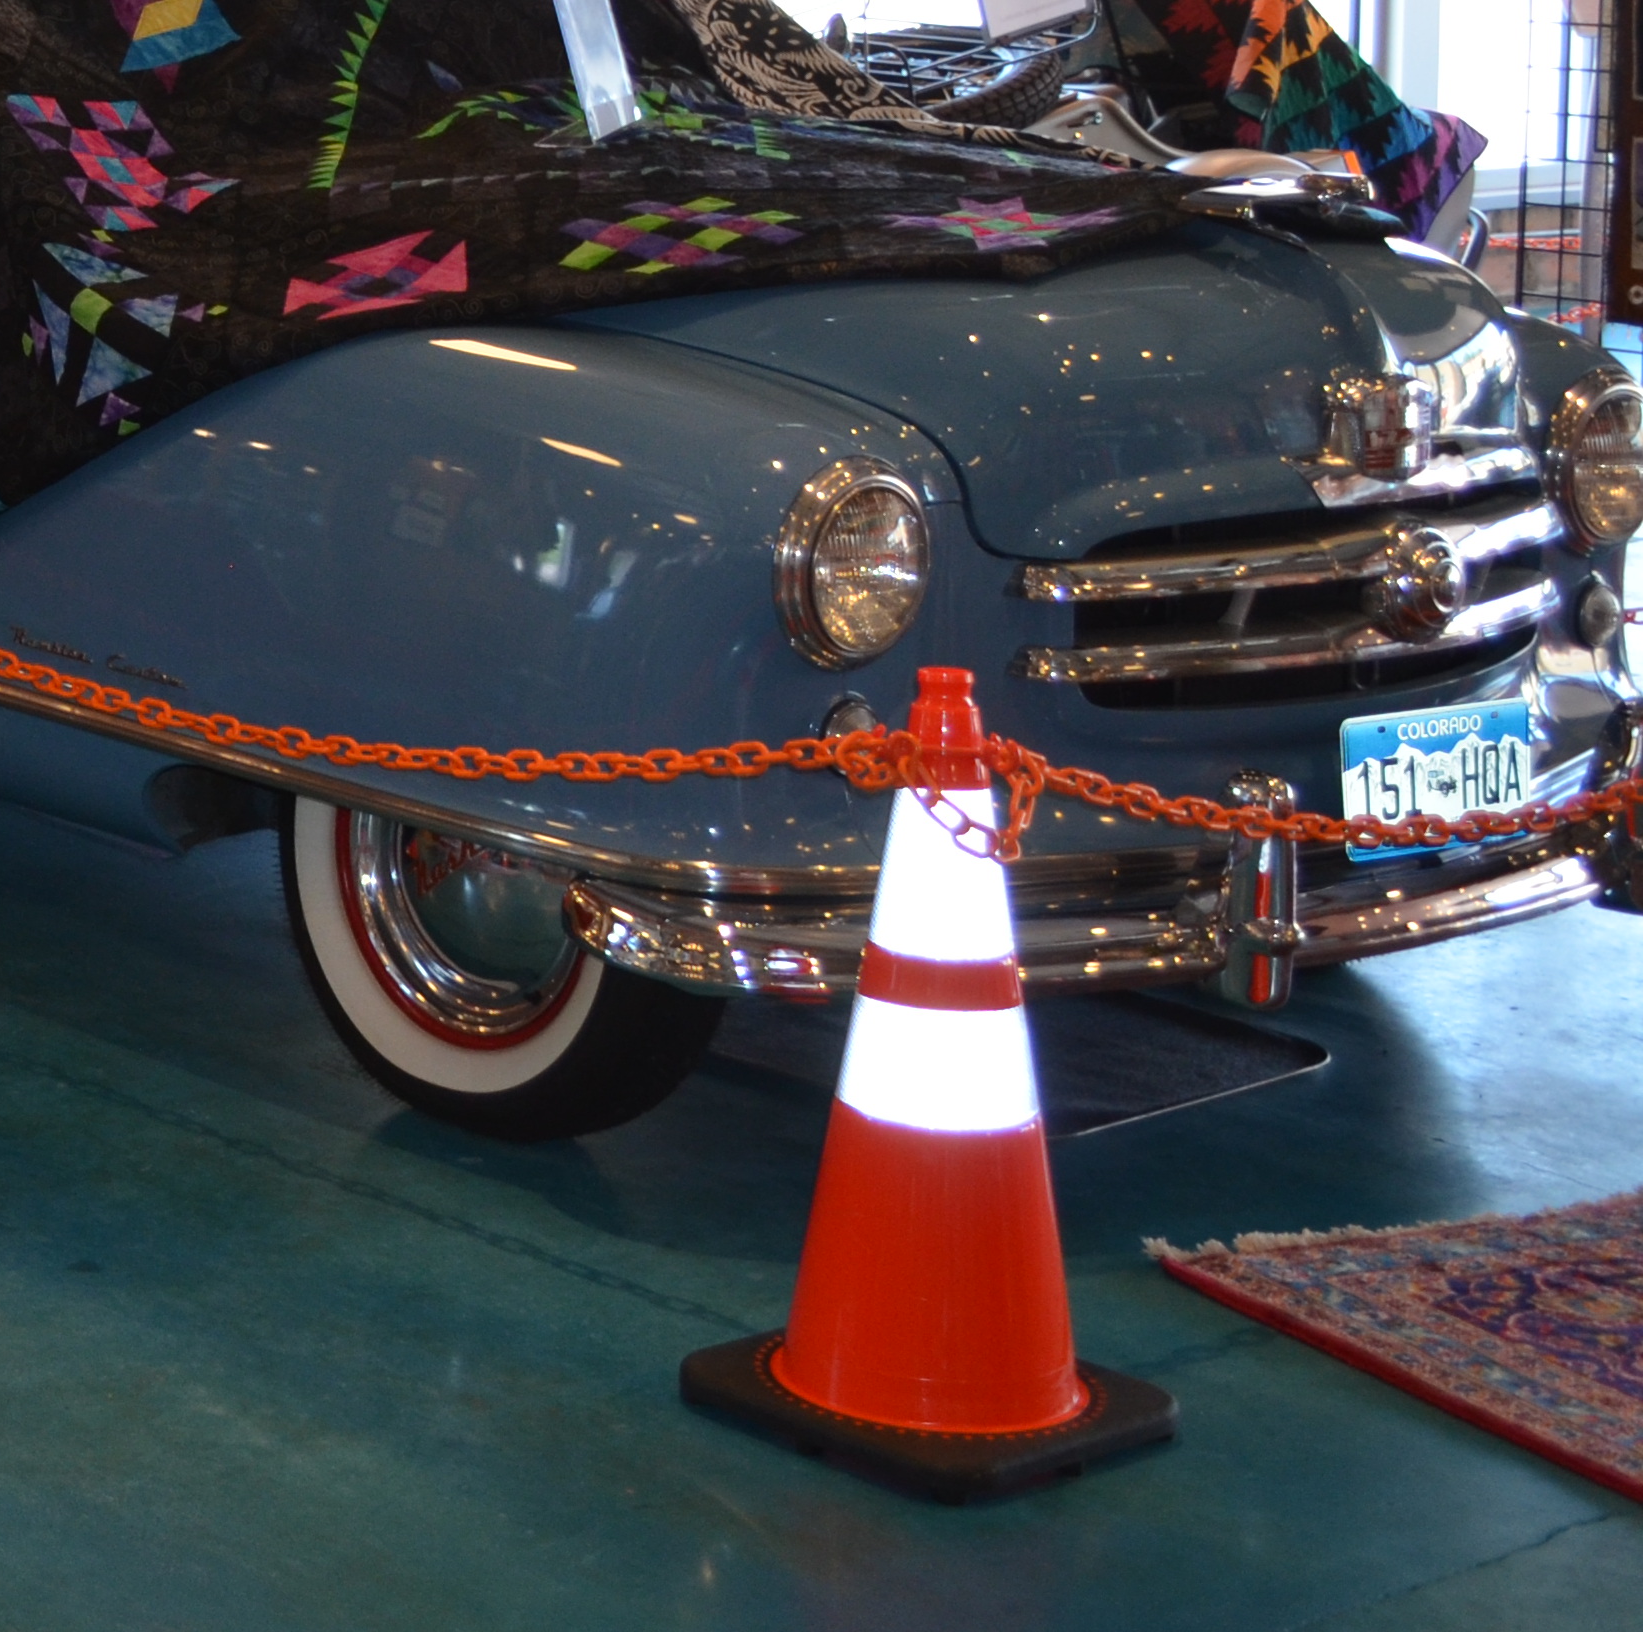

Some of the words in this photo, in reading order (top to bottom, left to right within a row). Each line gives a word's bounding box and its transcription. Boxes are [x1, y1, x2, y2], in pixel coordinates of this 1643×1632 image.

[1397, 714, 1482, 741] COLORADO
[1357, 755, 1422, 819] 151
[1461, 741, 1522, 810] HQA
